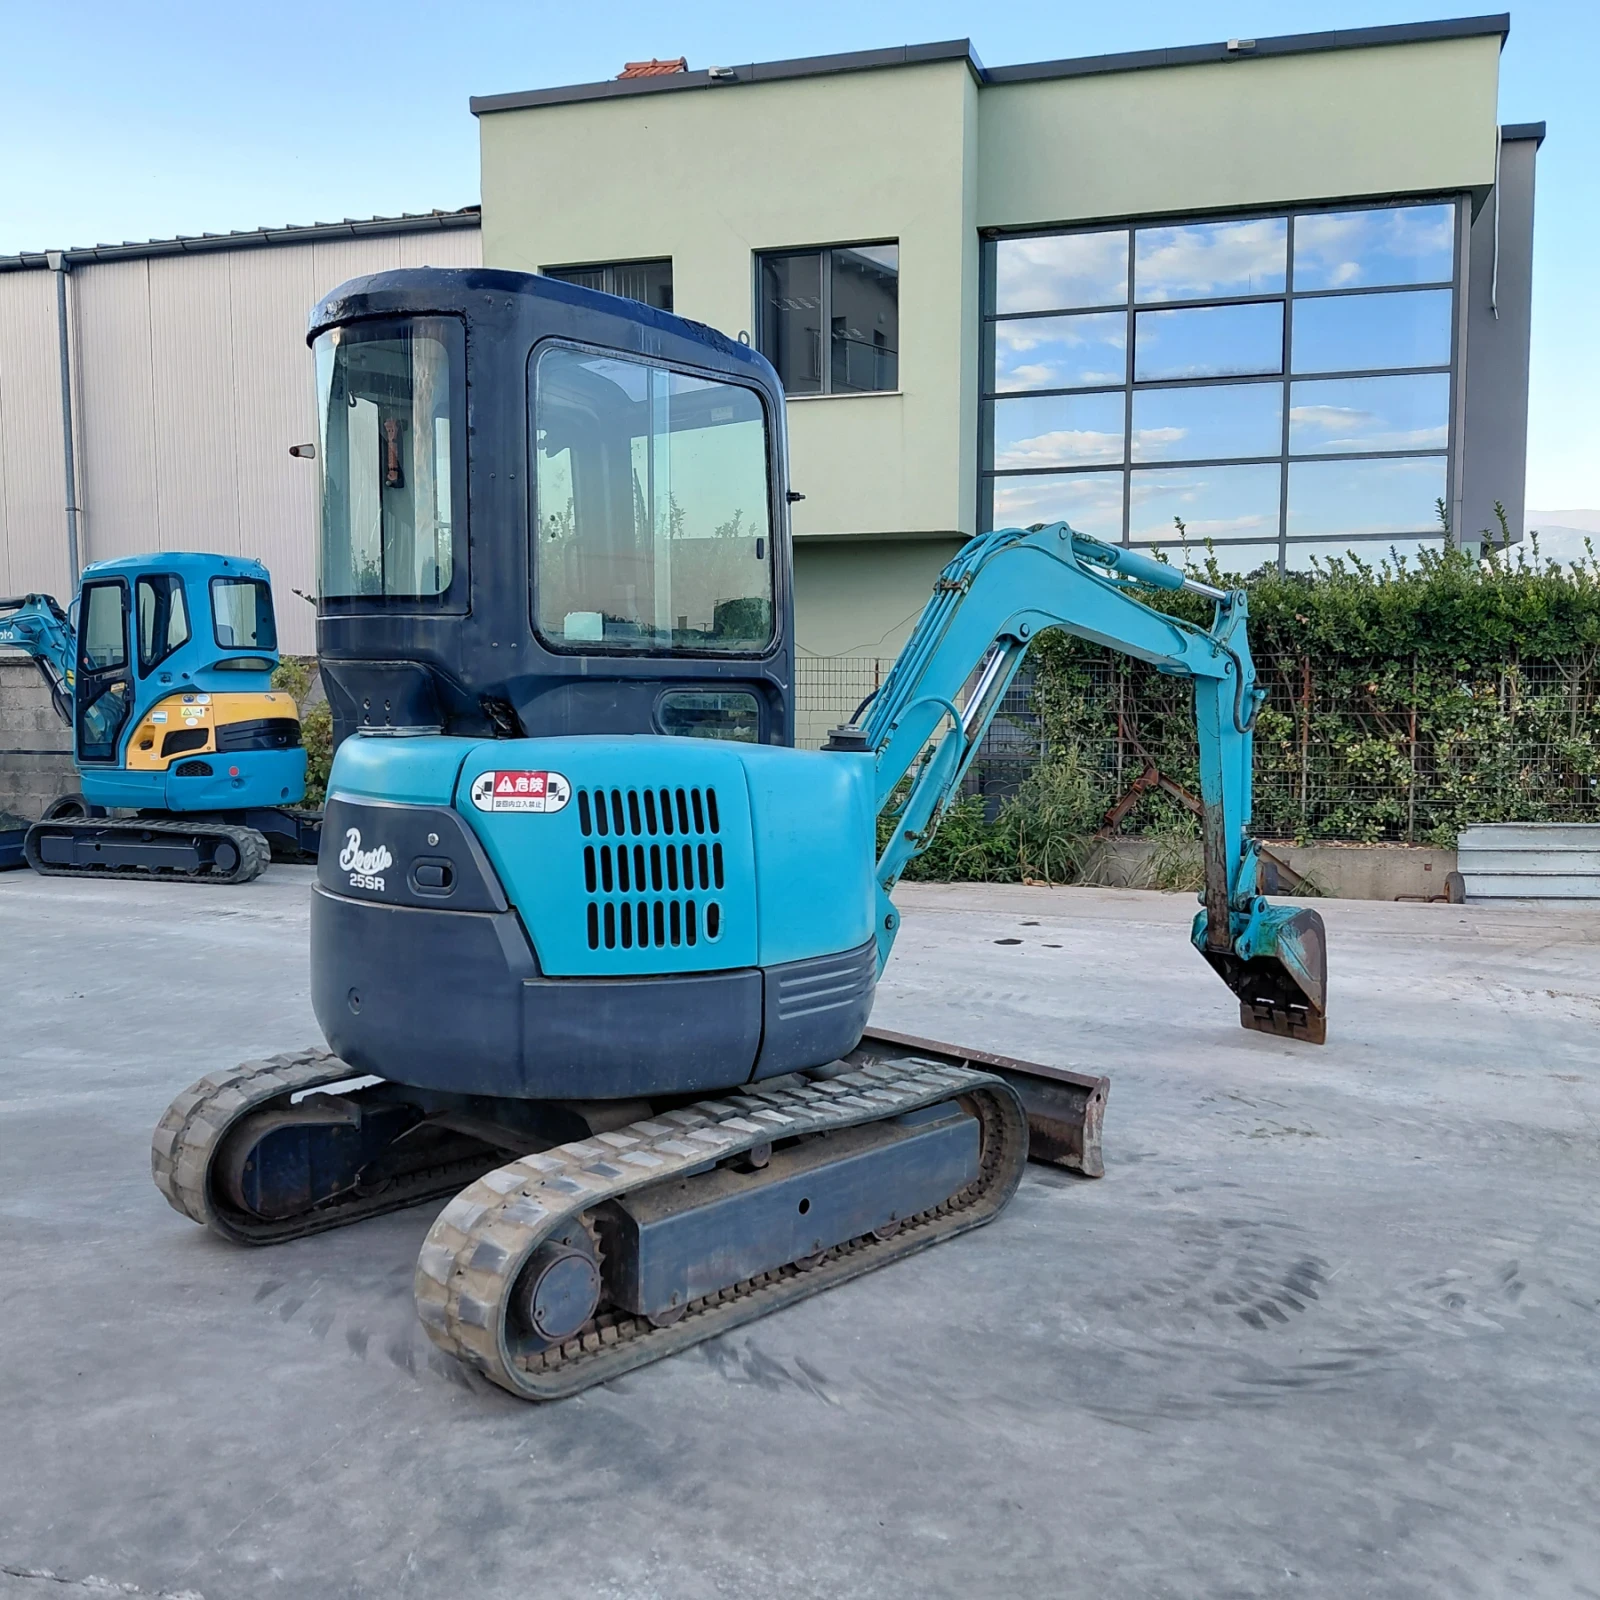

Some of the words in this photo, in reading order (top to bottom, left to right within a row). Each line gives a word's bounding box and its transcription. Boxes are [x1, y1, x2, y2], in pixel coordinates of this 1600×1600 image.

[515, 777, 545, 793] 危険
[339, 827, 393, 875] Beetle
[349, 873, 385, 892] 25SR
